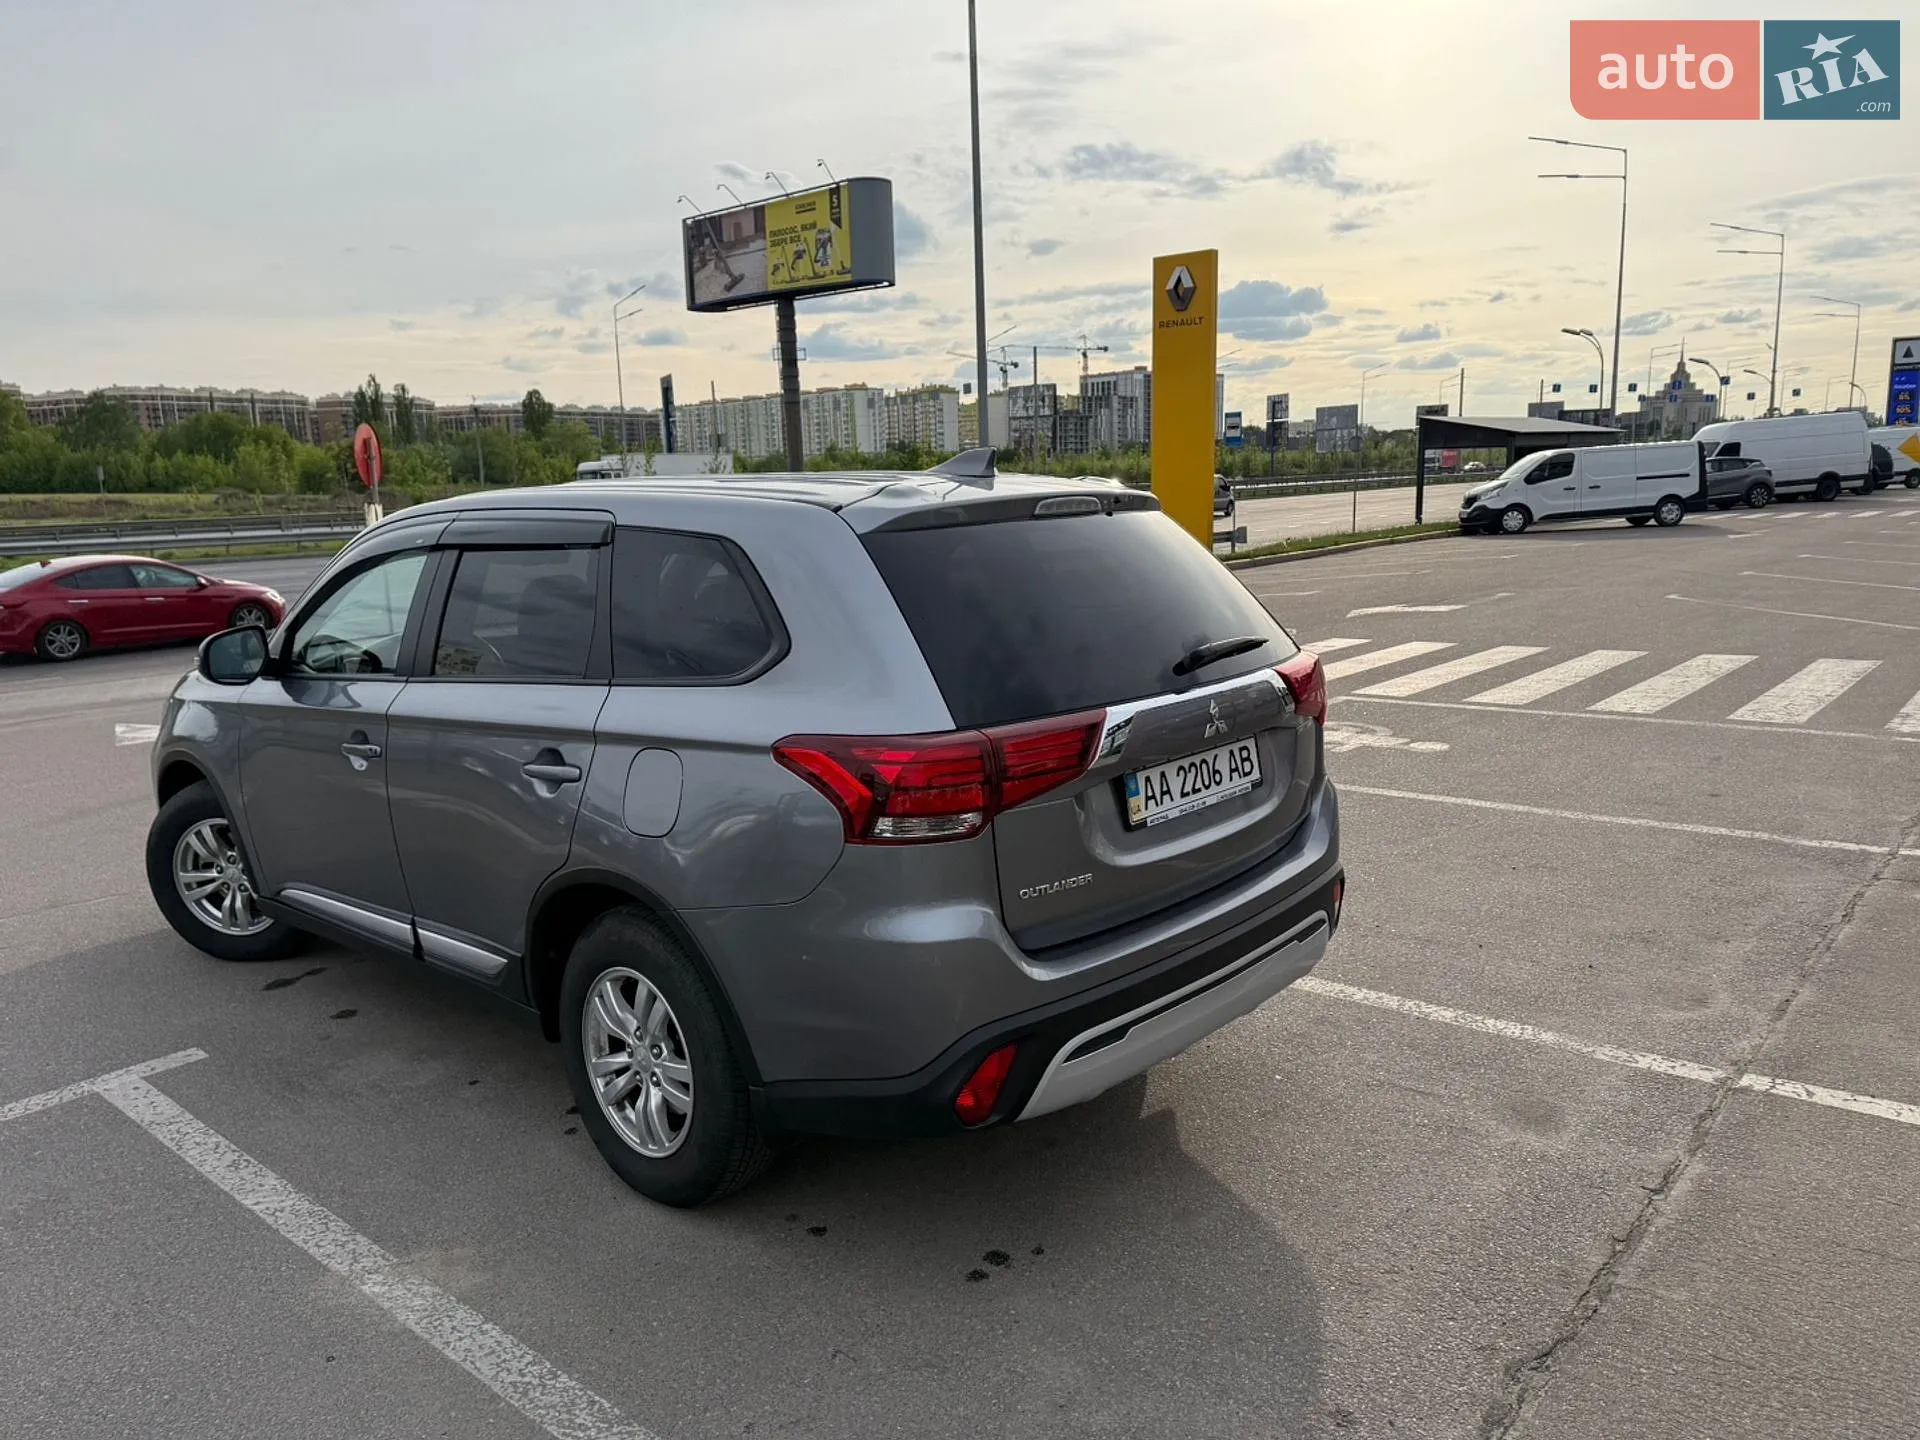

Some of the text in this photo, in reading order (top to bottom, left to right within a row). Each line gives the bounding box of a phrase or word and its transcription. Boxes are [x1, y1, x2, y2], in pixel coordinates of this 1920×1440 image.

[1158, 316, 1205, 329] RENAULT
[1144, 770, 1174, 811] AA
[1176, 754, 1223, 798] 2206
[1229, 745, 1254, 782] AB
[1020, 873, 1093, 899] OUTLANDER
